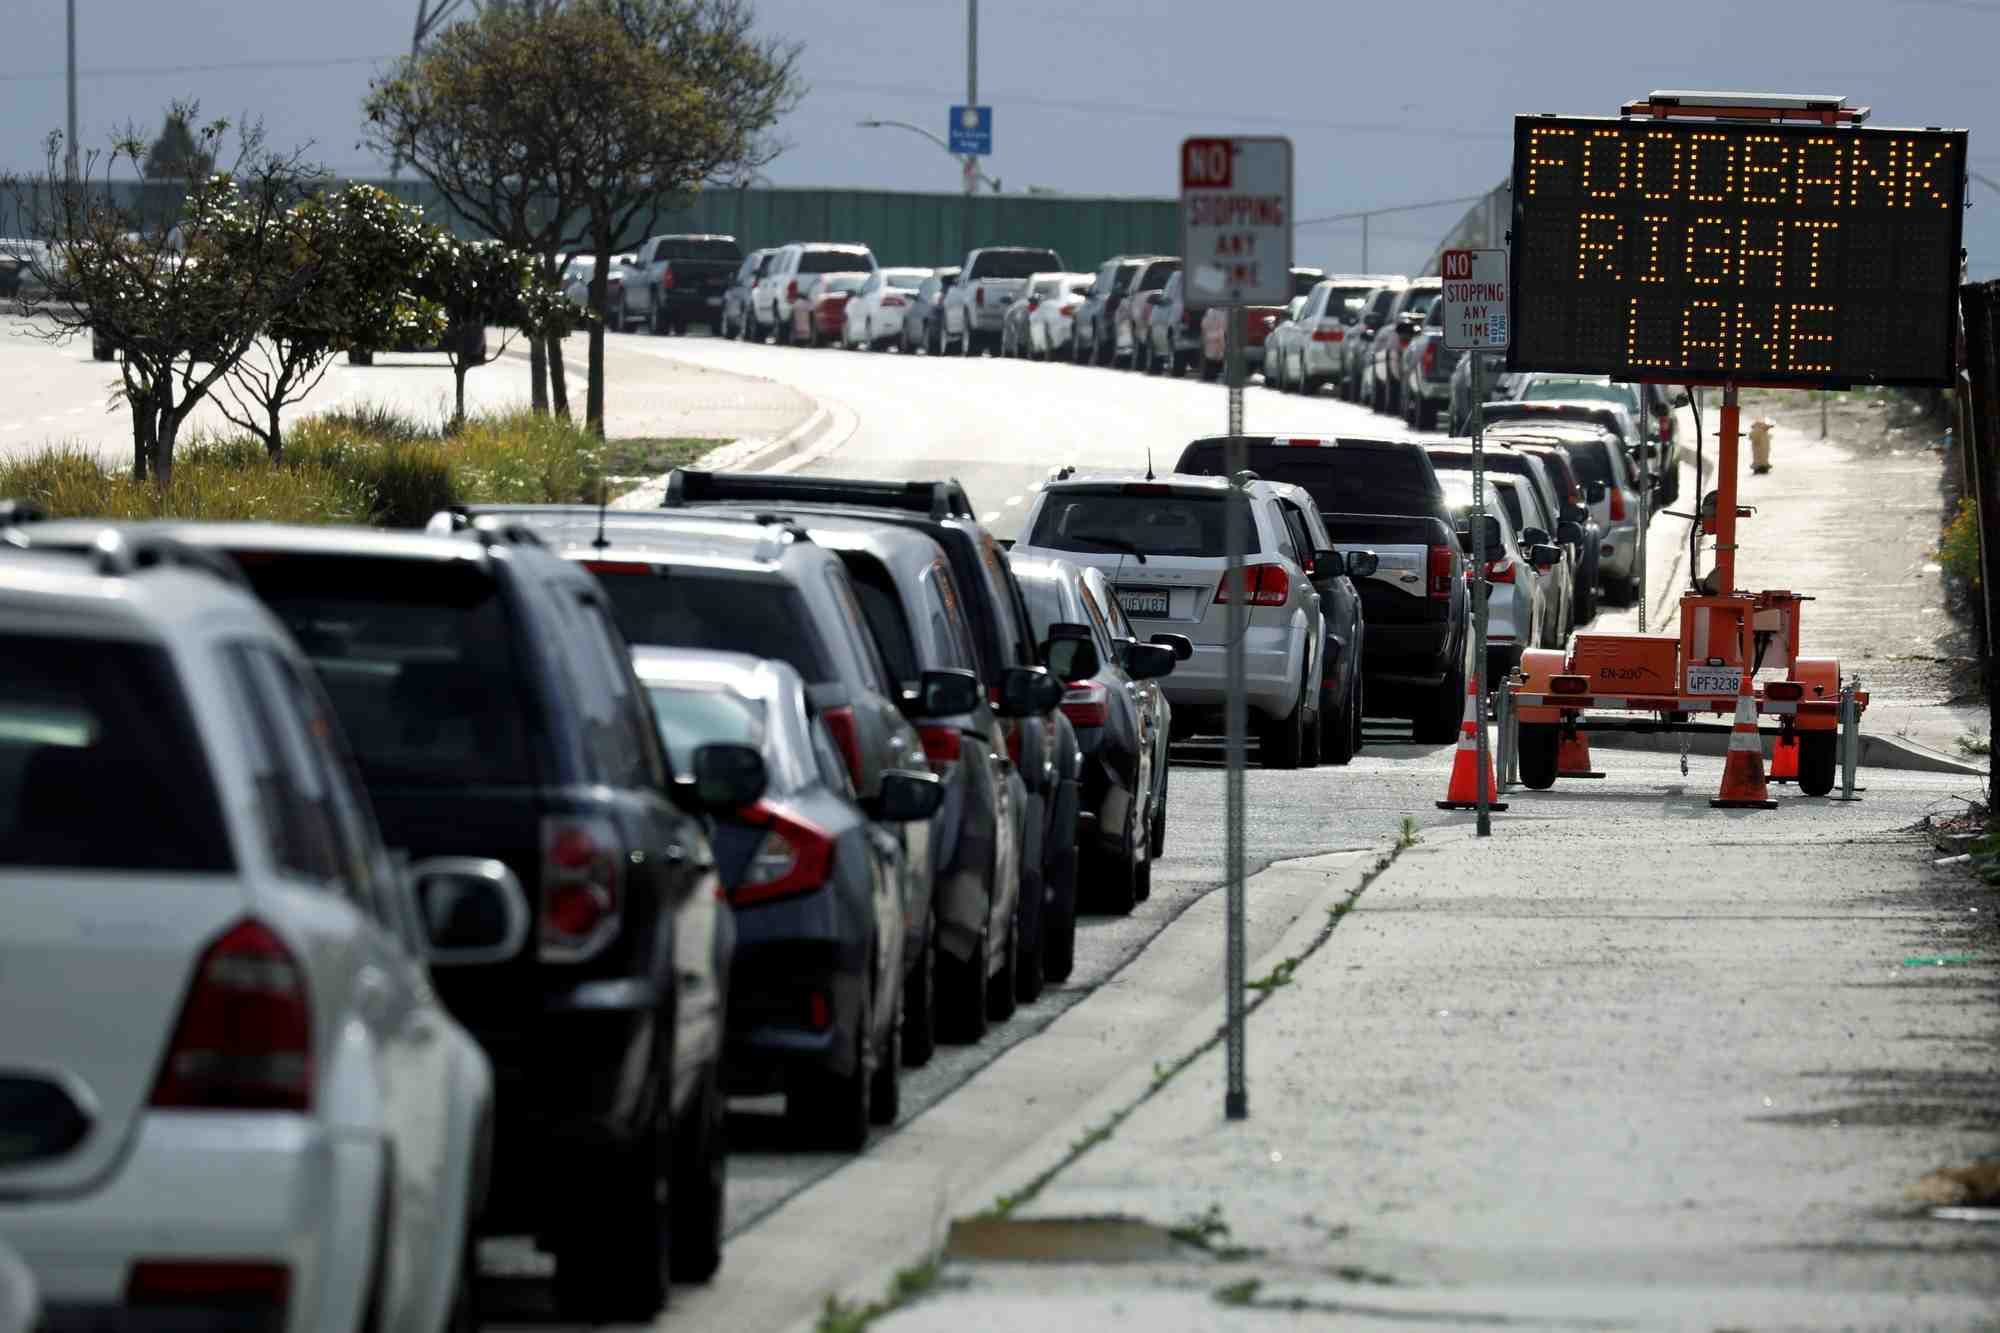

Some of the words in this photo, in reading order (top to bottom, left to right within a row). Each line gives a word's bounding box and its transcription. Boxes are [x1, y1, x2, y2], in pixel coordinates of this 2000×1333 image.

[1529, 129, 1951, 209] FOODBANK
[1577, 212, 1839, 289] RIGHT
[1447, 254, 1469, 276] NO
[1447, 284, 1504, 303] STOPPING
[1463, 305, 1488, 320] ANY
[1463, 323, 1488, 337] TIME
[1626, 296, 1836, 373] LANE
[1600, 667, 1642, 680] EN-200
[1690, 676, 1739, 691] 4PF3238
